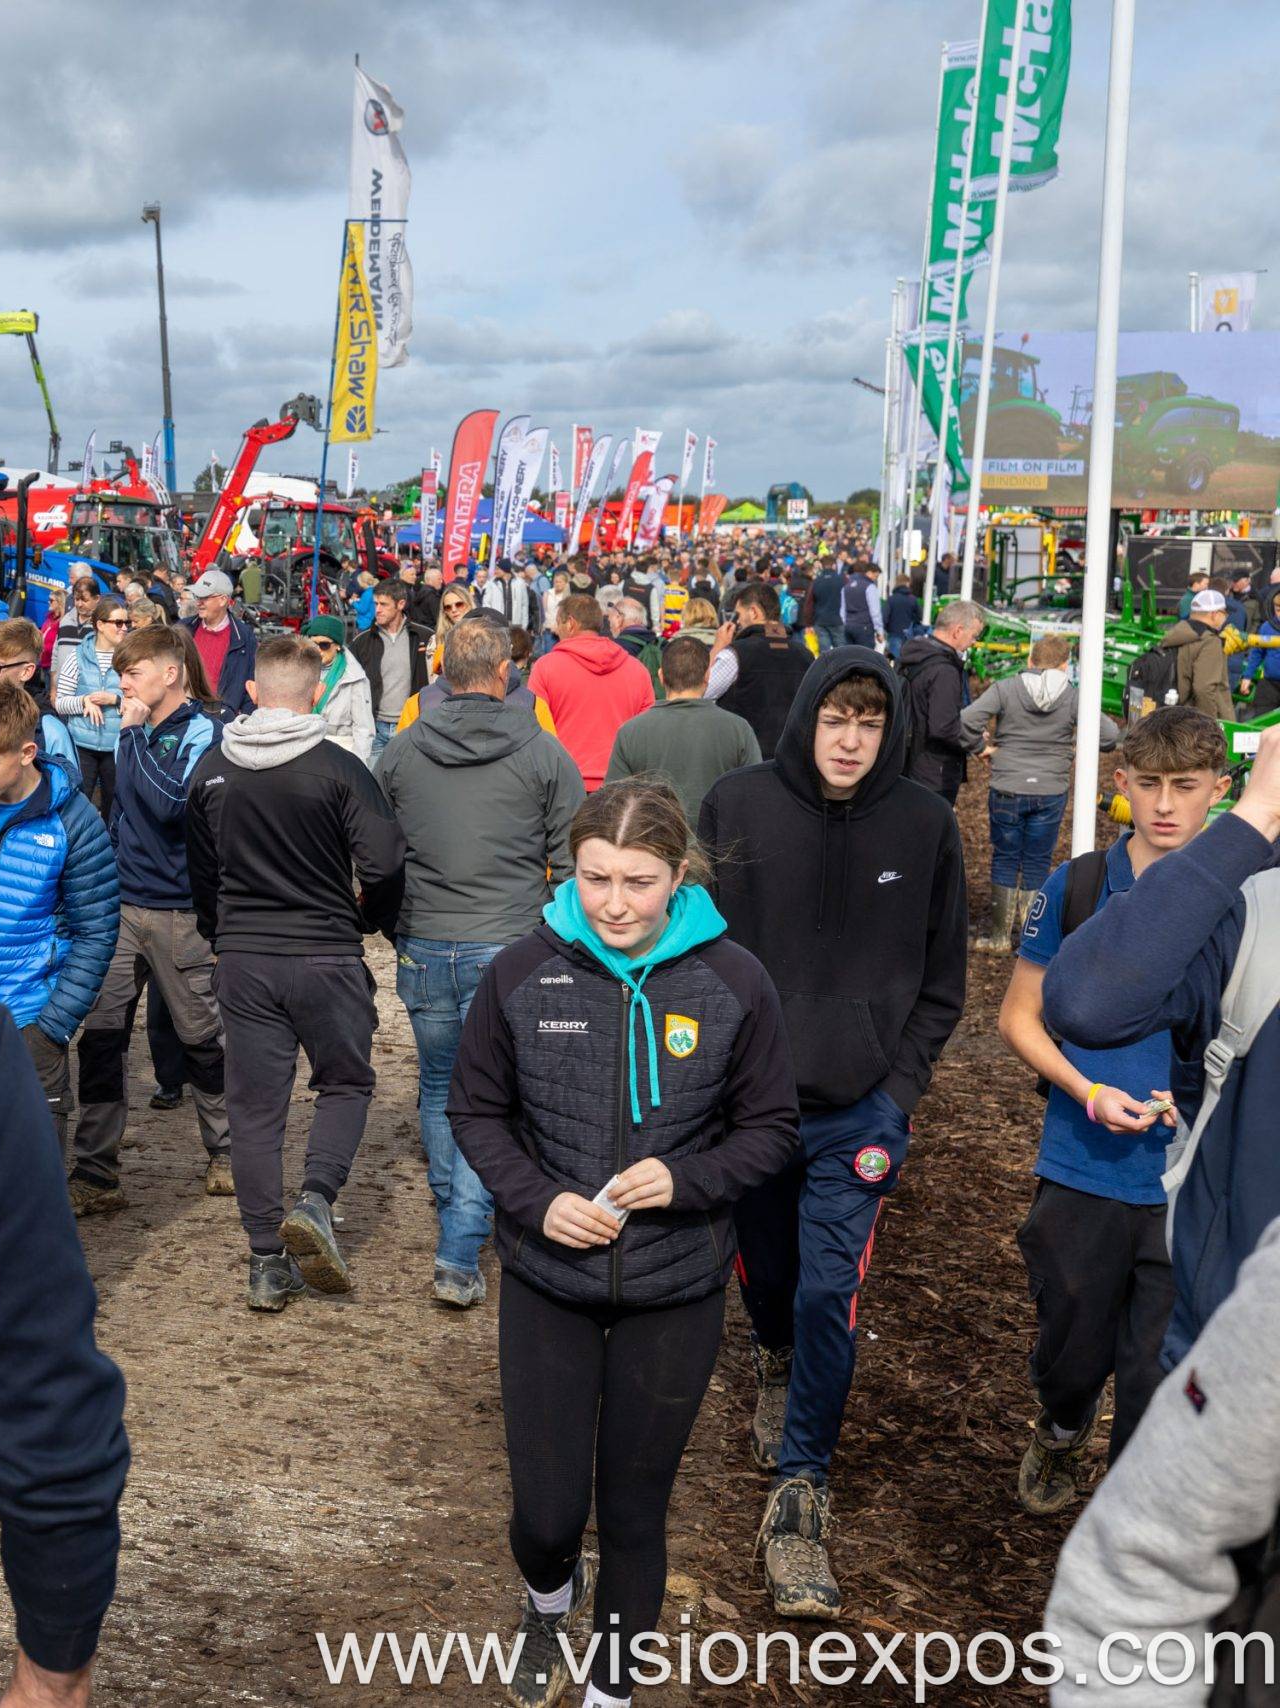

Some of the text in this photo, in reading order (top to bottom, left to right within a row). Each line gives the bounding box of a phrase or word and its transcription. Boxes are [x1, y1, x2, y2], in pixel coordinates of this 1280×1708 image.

[988, 461, 1078, 473] FILM ON FILM
[538, 1020, 589, 1030] KERRY
